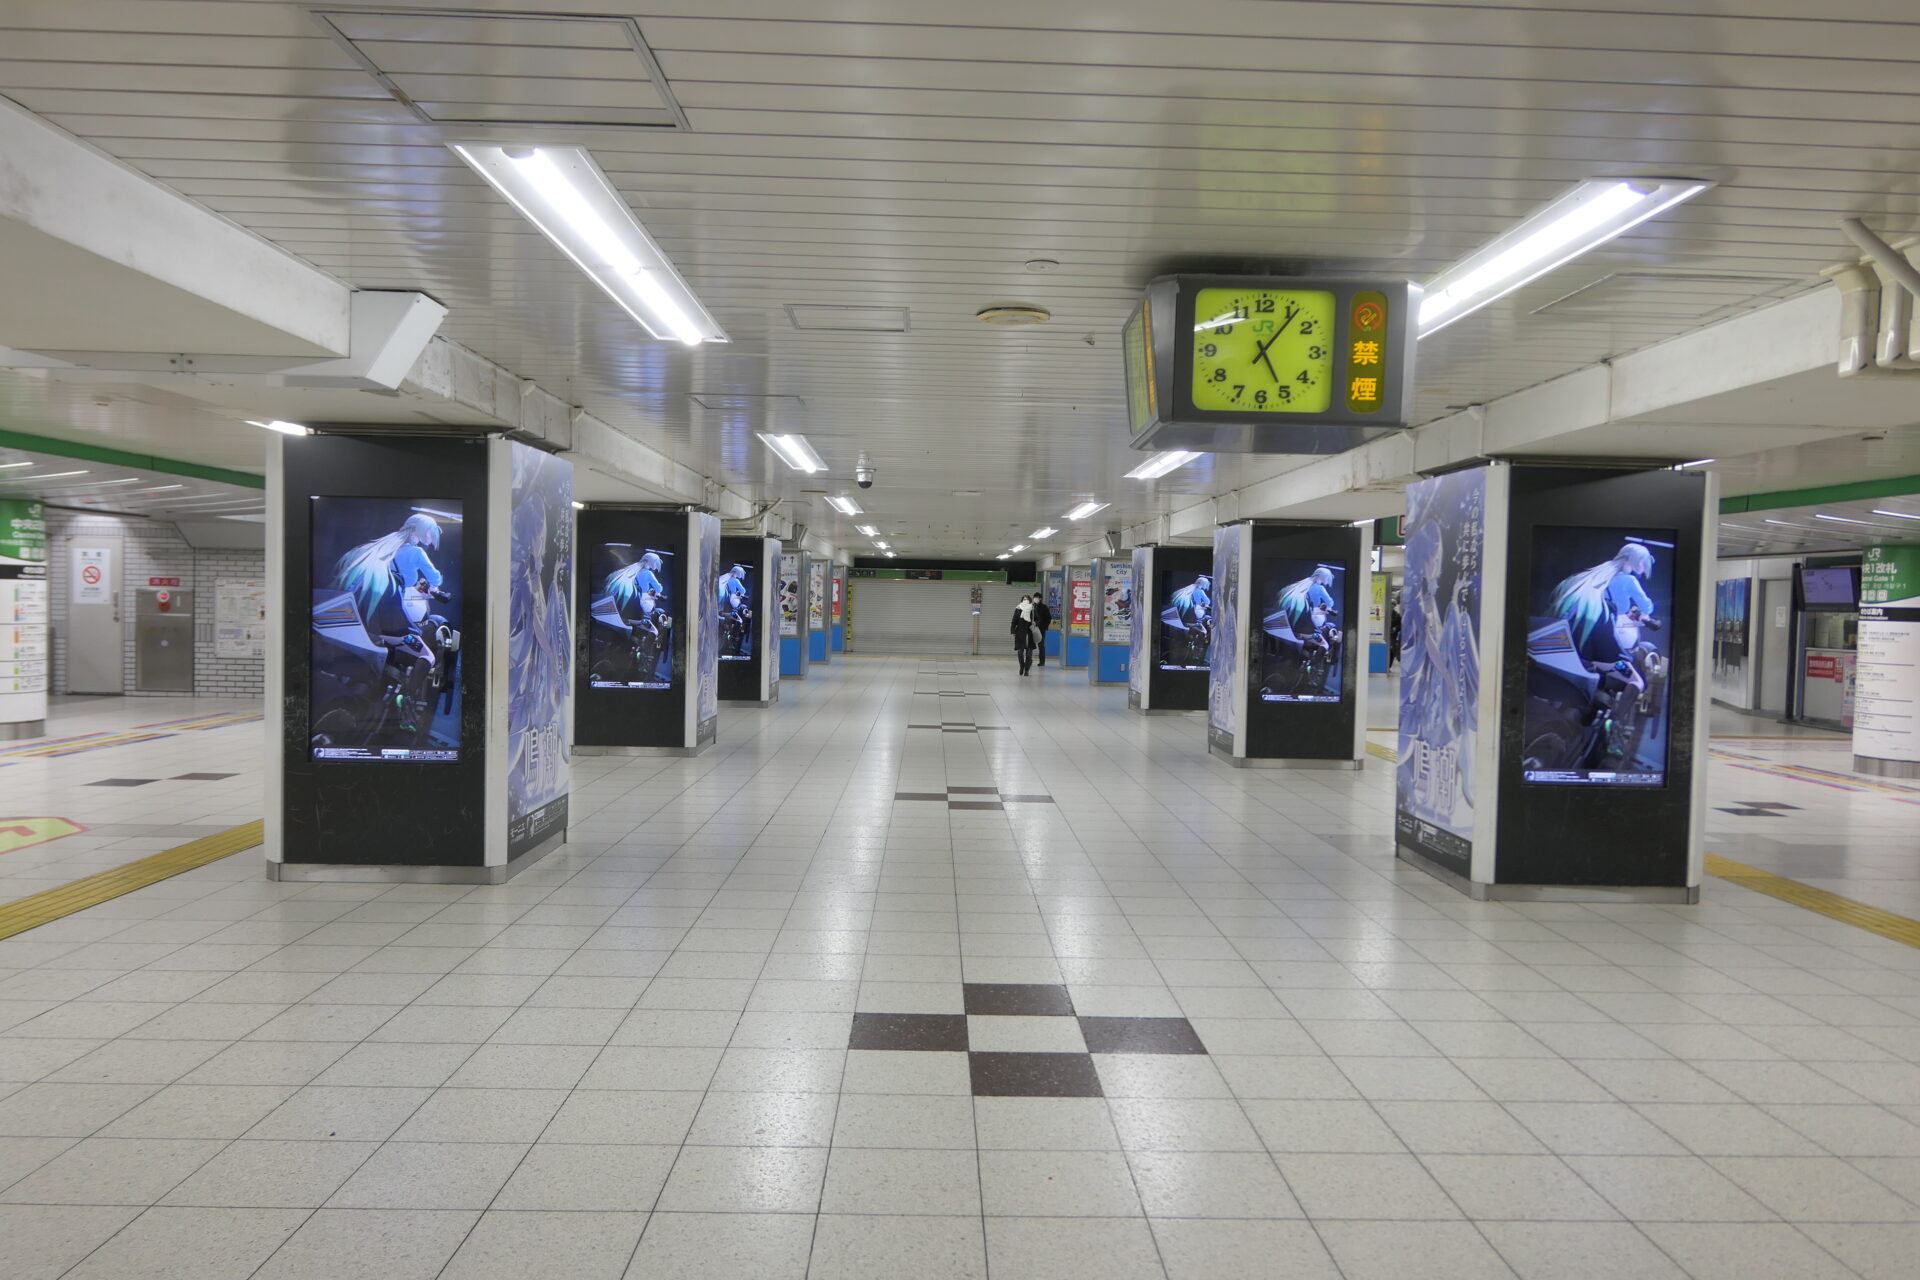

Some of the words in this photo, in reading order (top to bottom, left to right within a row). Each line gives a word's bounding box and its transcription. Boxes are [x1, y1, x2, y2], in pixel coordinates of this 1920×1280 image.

[1233, 305, 1249, 319] 11
[1255, 299, 1275, 313] 12
[1284, 305, 1292, 319] 1
[1252, 320, 1274, 334] JR
[1299, 322, 1314, 335] 2
[1203, 344, 1217, 358] 9
[1309, 346, 1322, 360] 3
[1213, 368, 1227, 382] 8
[1296, 370, 1310, 384] 4
[1351, 340, 1379, 402] 禁煙
[1232, 385, 1246, 398] 7
[1254, 389, 1268, 404] 6
[1278, 386, 1291, 399] 5
[1867, 548, 1880, 558] JR
[1116, 568, 1128, 576] City
